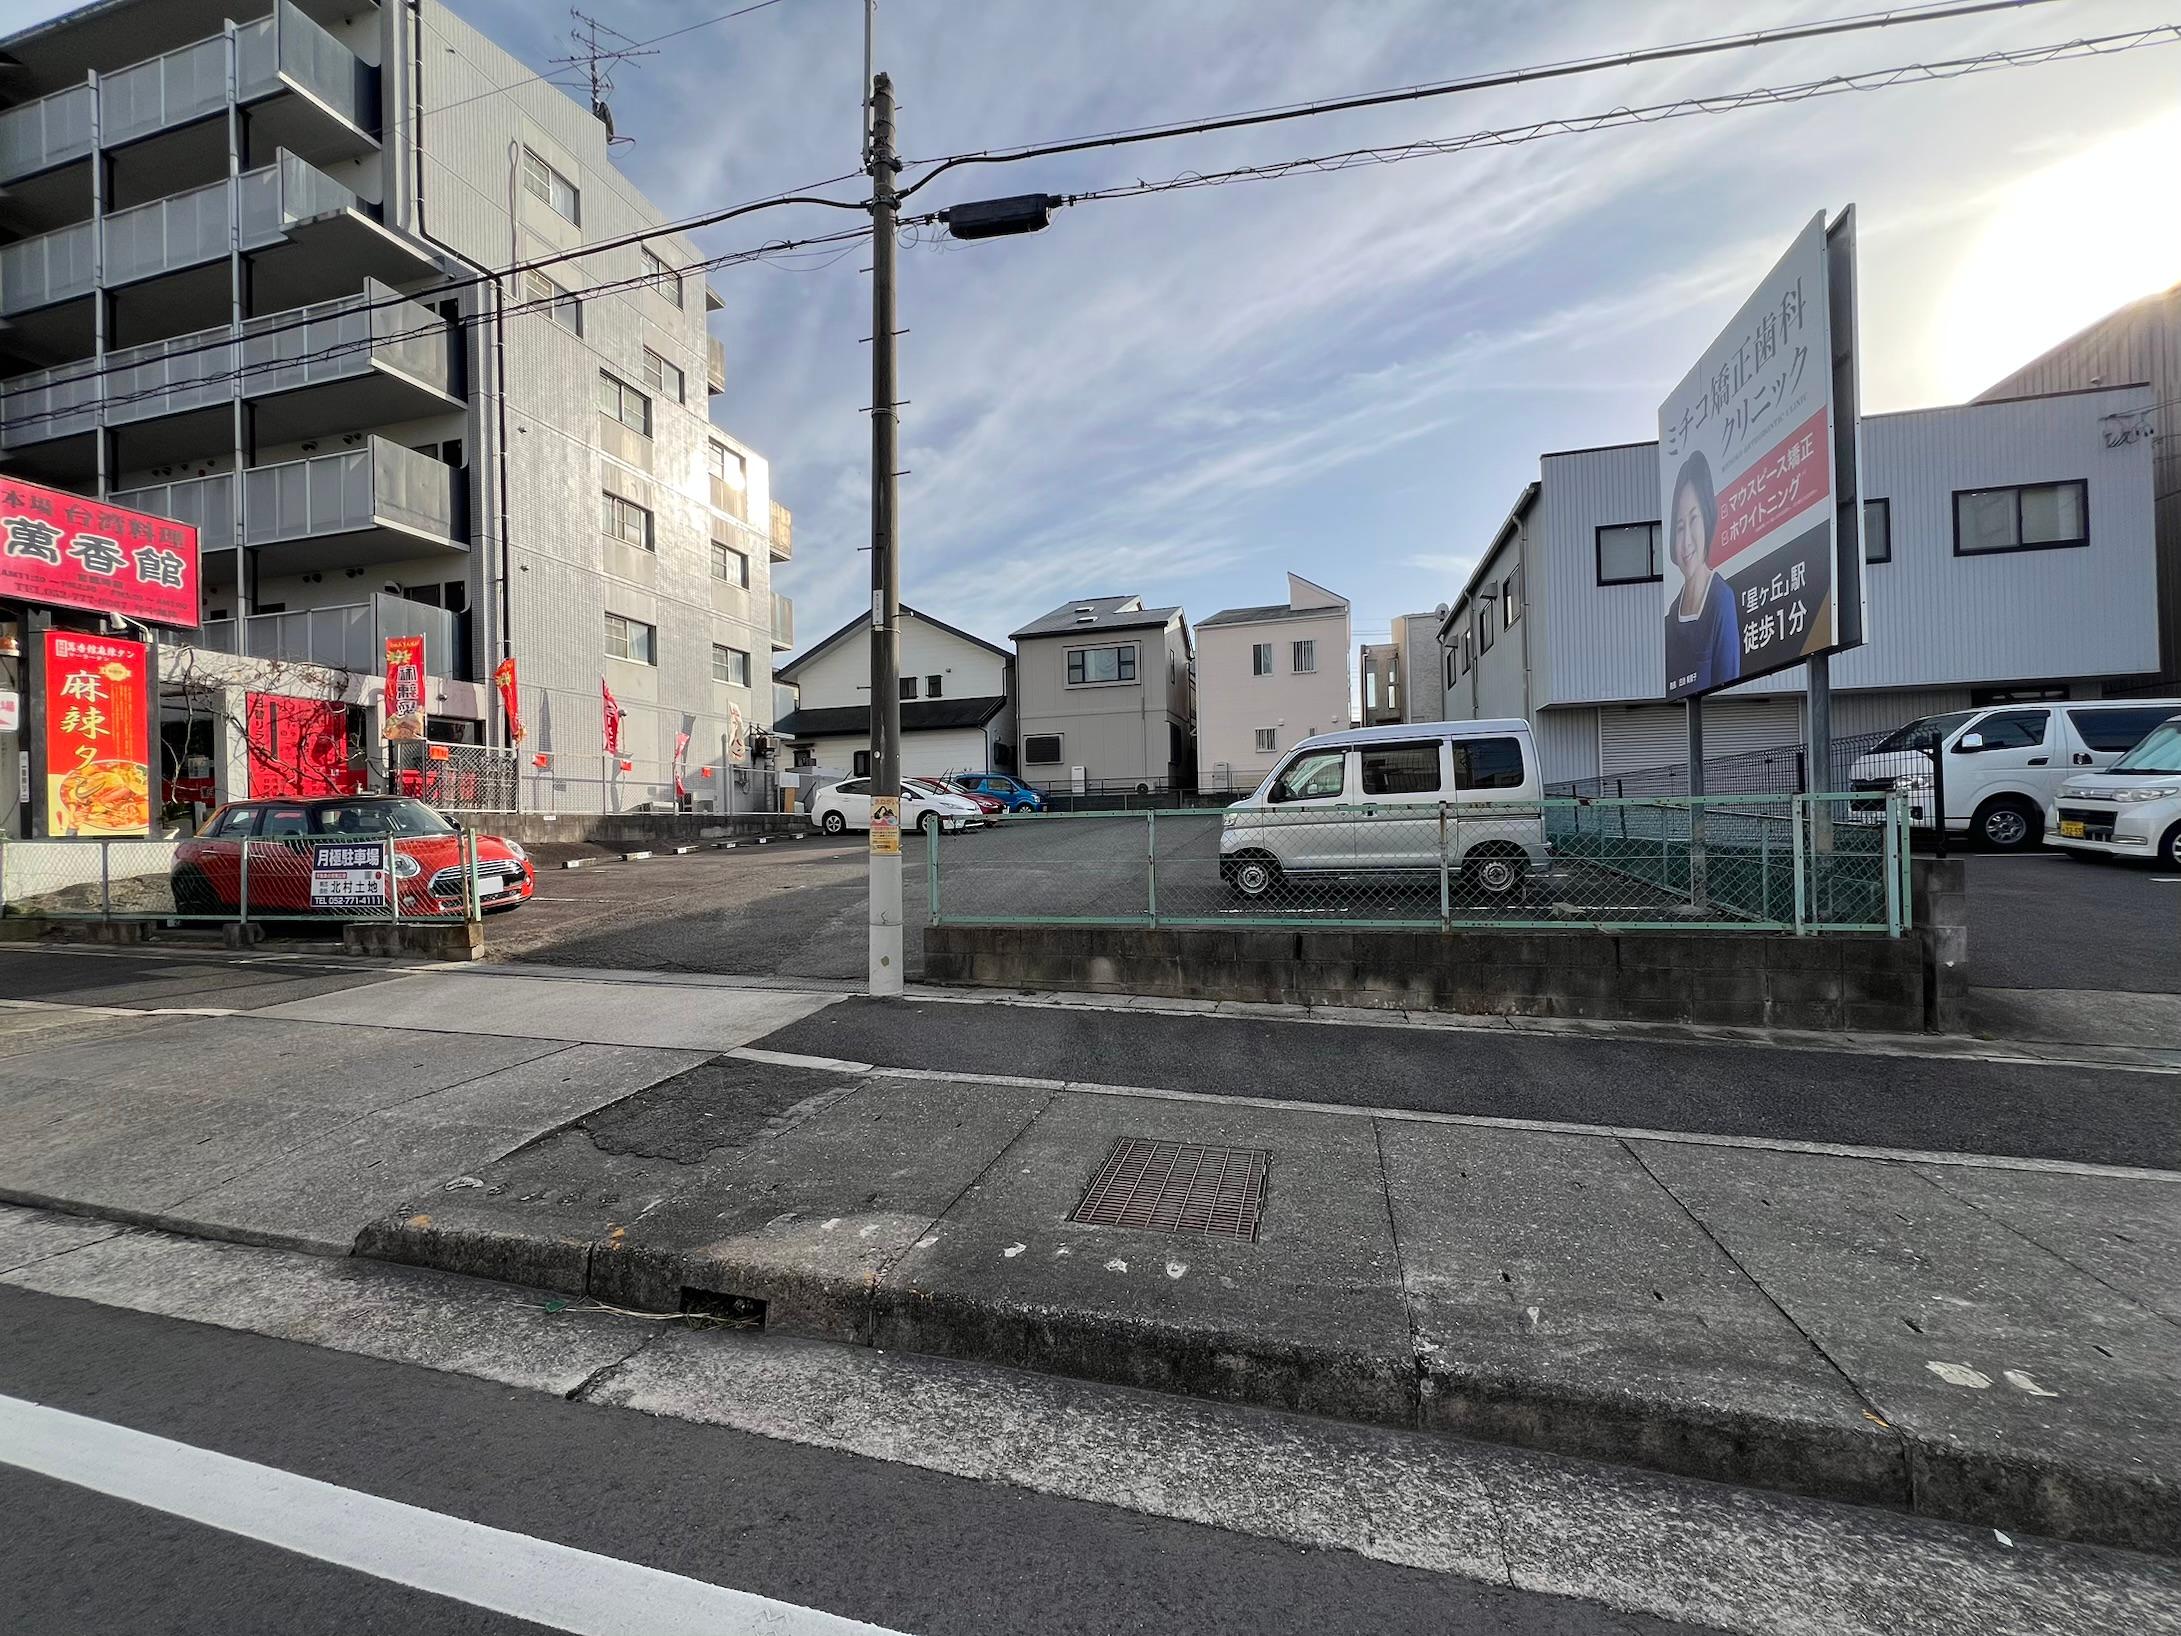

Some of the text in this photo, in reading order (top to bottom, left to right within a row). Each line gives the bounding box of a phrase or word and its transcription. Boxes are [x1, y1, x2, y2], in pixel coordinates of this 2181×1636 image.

[1668, 277, 1806, 455] ミチコ矯正歯科
[1722, 346, 1808, 457] クリニック
[1729, 432, 1814, 511] マウスピース矯正
[1730, 473, 1801, 541] ホワイトニング
[2, 517, 186, 588] 萬香館
[1743, 600, 1807, 654] 徒歩1分
[60, 669, 111, 799] 麻辣タン
[317, 848, 380, 867] 月極駐車場
[330, 880, 378, 894] 北村土地
[314, 896, 381, 905] TEL 052-771-4111
